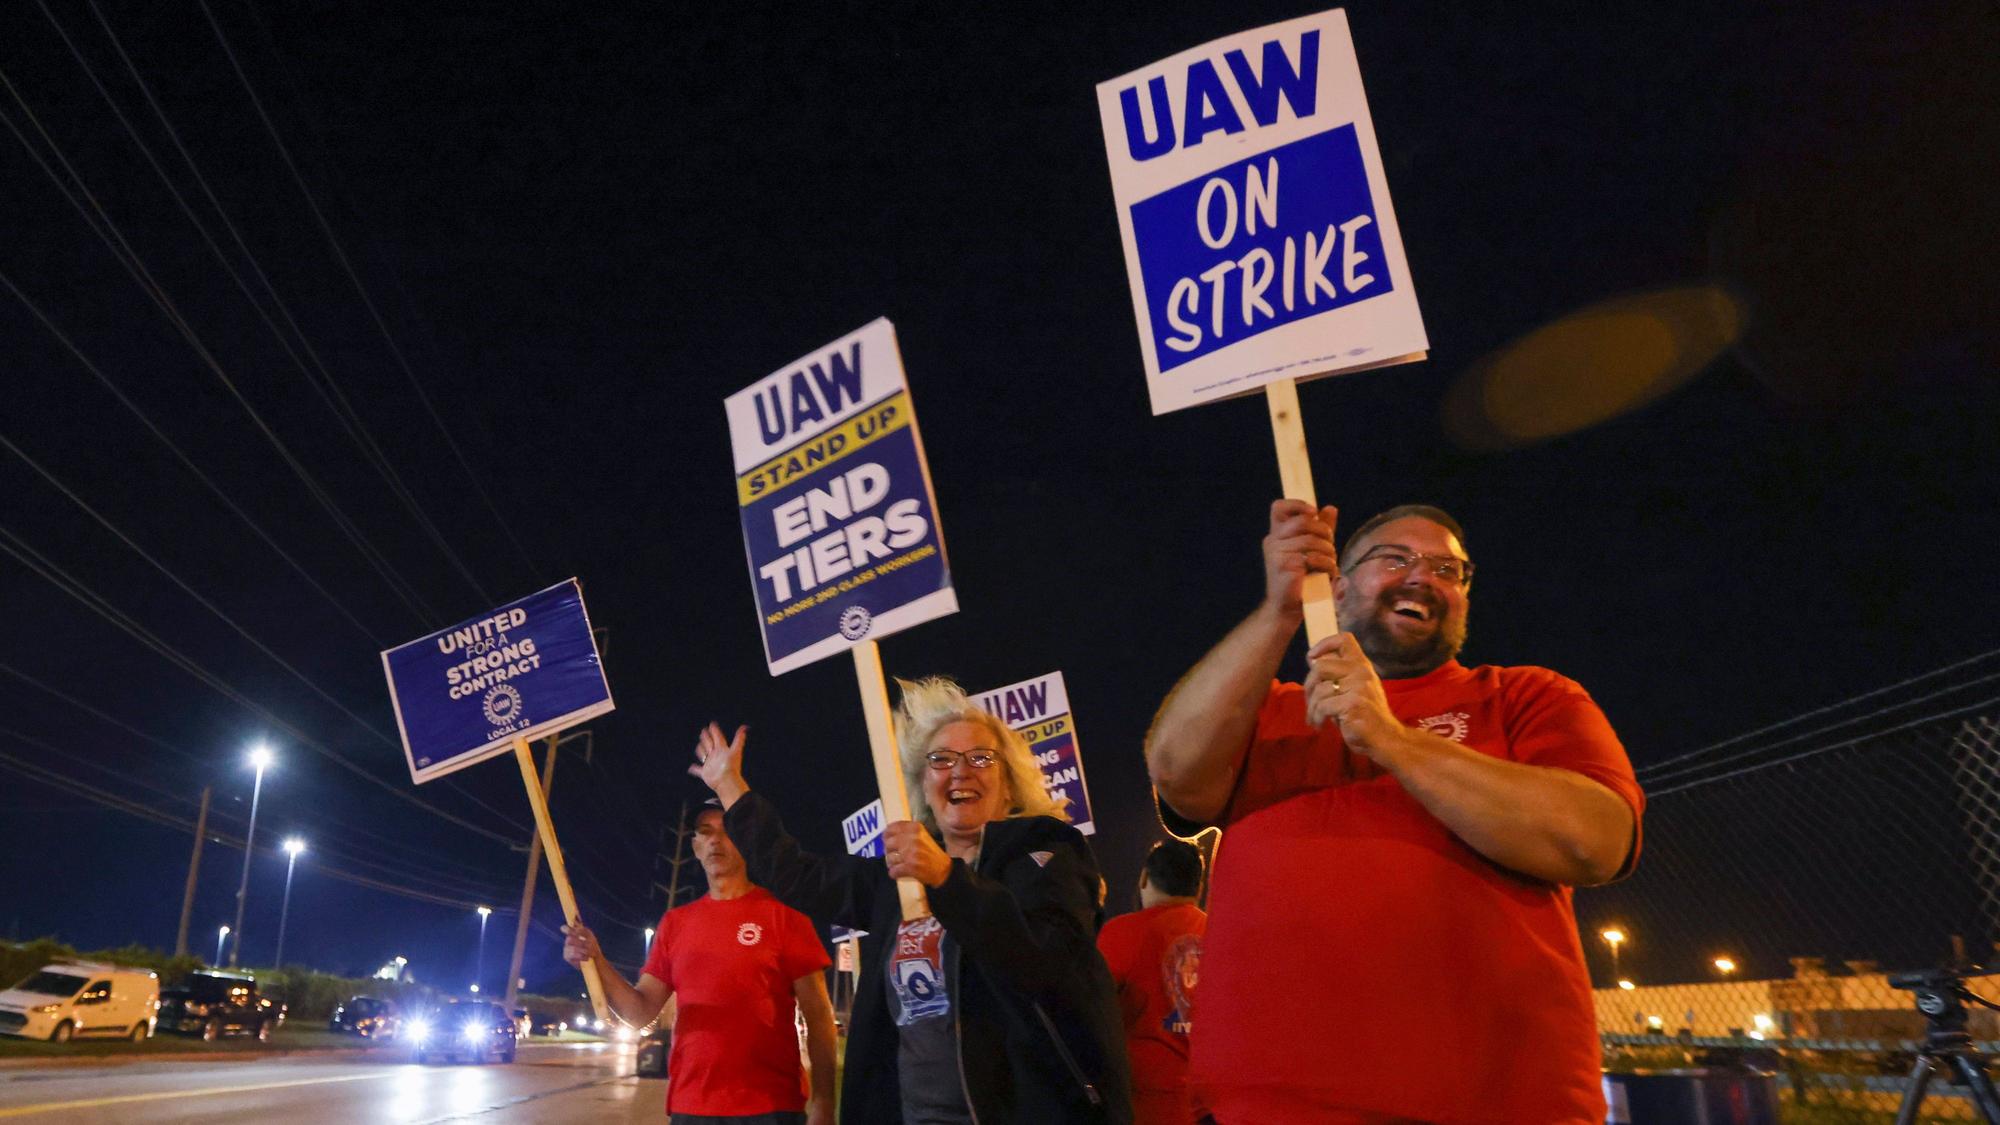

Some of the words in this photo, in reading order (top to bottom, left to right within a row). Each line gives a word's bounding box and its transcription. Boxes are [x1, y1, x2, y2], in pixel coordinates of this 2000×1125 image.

[1119, 29, 1320, 162] UAW
[1197, 156, 1279, 250] ON
[1165, 215, 1375, 352] STRIKE
[754, 342, 862, 445] UAW
[749, 435, 846, 495] STAND
[856, 406, 897, 440] UP
[773, 462, 890, 547] END
[760, 498, 928, 603] TIERS
[838, 569, 877, 592] CLASS
[438, 608, 527, 654] UNITED
[466, 638, 496, 659] FOR
[498, 633, 508, 647] A
[446, 638, 536, 685] STRONG
[449, 654, 540, 700] CONTRACT
[984, 681, 1046, 724] UAW
[487, 725, 517, 741] LOCAL
[1043, 720, 1065, 736] UP
[846, 806, 878, 844] UAW
